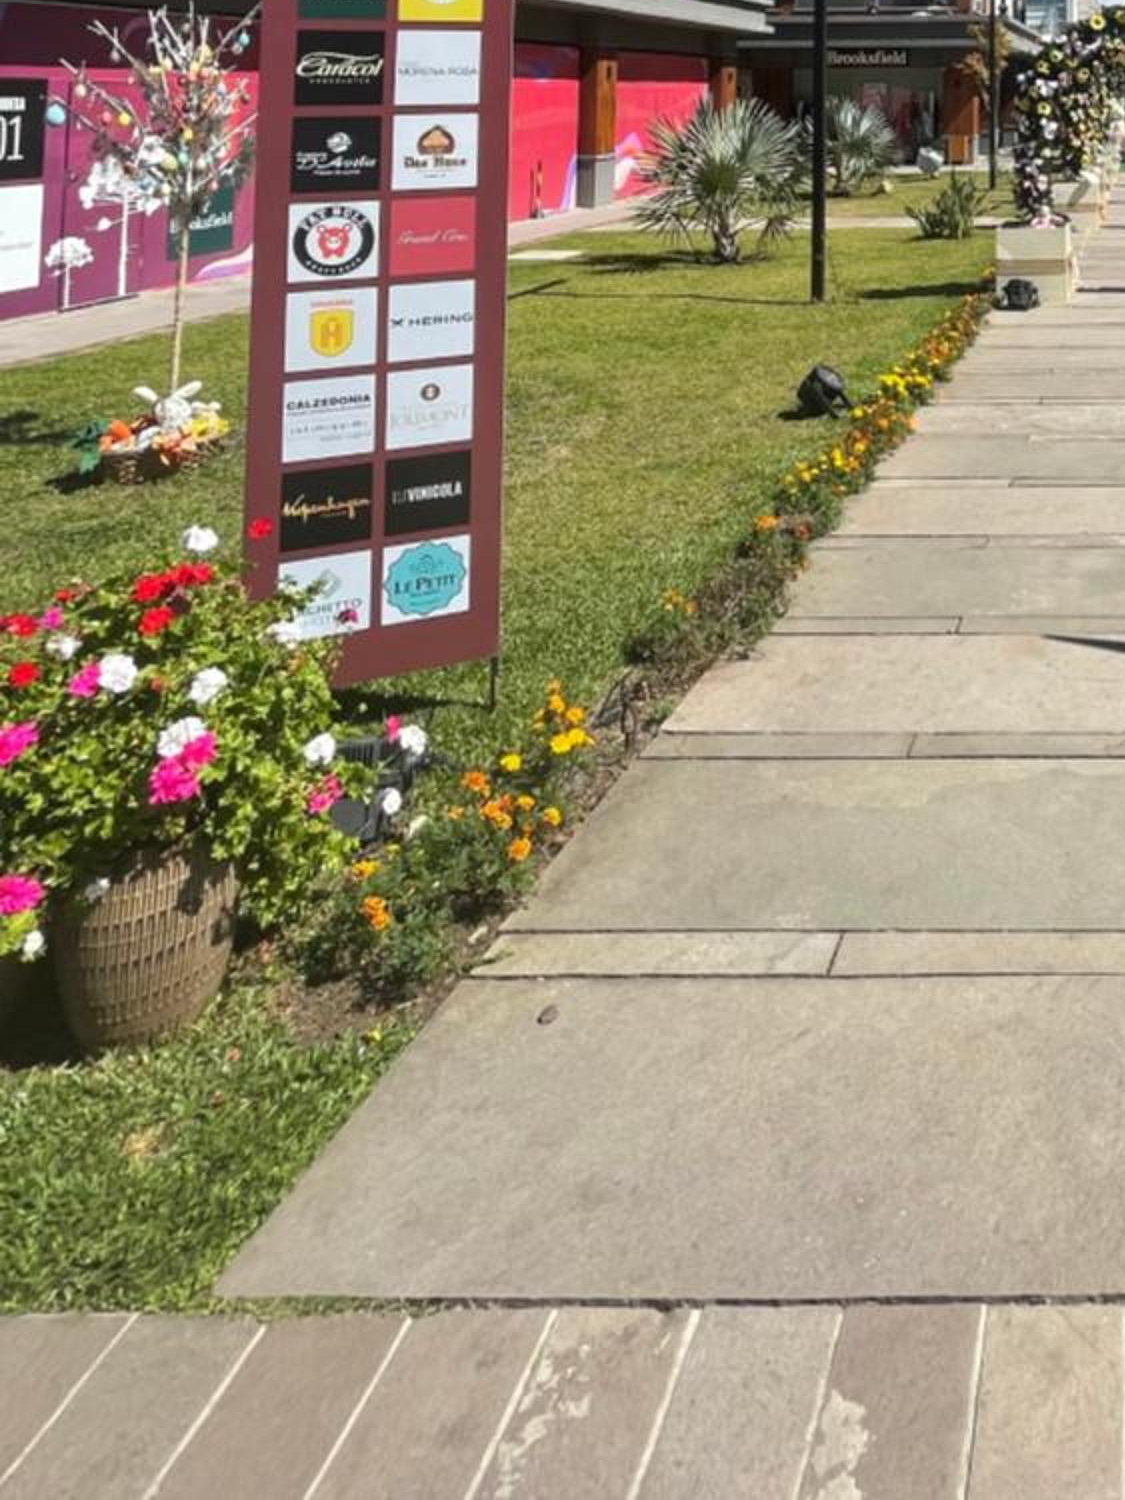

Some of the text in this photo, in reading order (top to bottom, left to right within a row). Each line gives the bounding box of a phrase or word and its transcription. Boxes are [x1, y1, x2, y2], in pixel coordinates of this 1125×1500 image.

[829, 51, 907, 66] Brooksfield
[408, 311, 473, 327] HERING
[286, 393, 371, 411] CALZEDONIA
